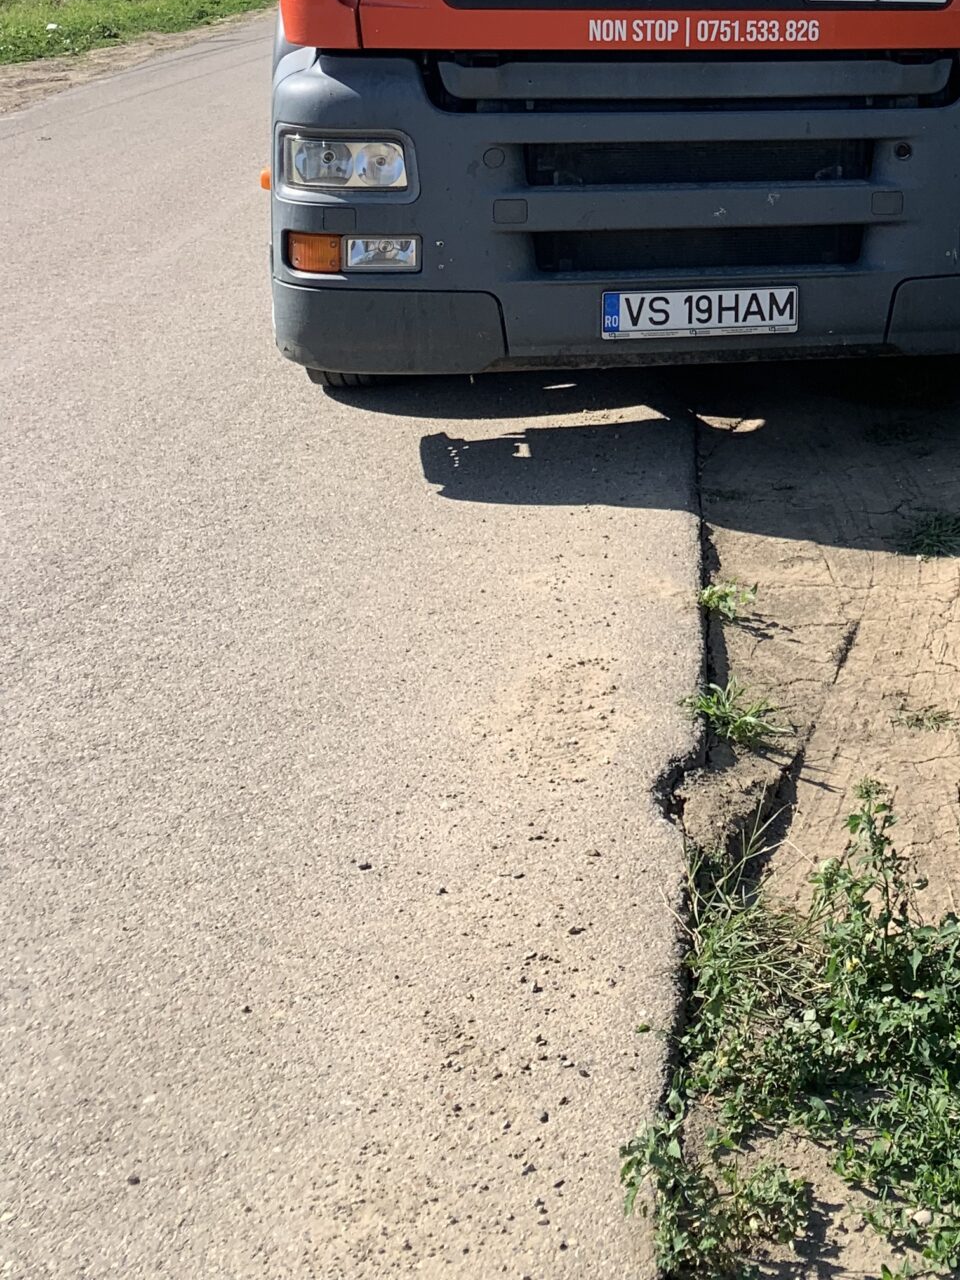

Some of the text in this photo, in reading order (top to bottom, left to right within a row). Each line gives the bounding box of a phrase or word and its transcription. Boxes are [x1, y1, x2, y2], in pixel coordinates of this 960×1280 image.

[589, 19, 820, 43] NON STOP 0751.533.826
[625, 291, 795, 327] VS 19HAM
[604, 315, 619, 328] RO
